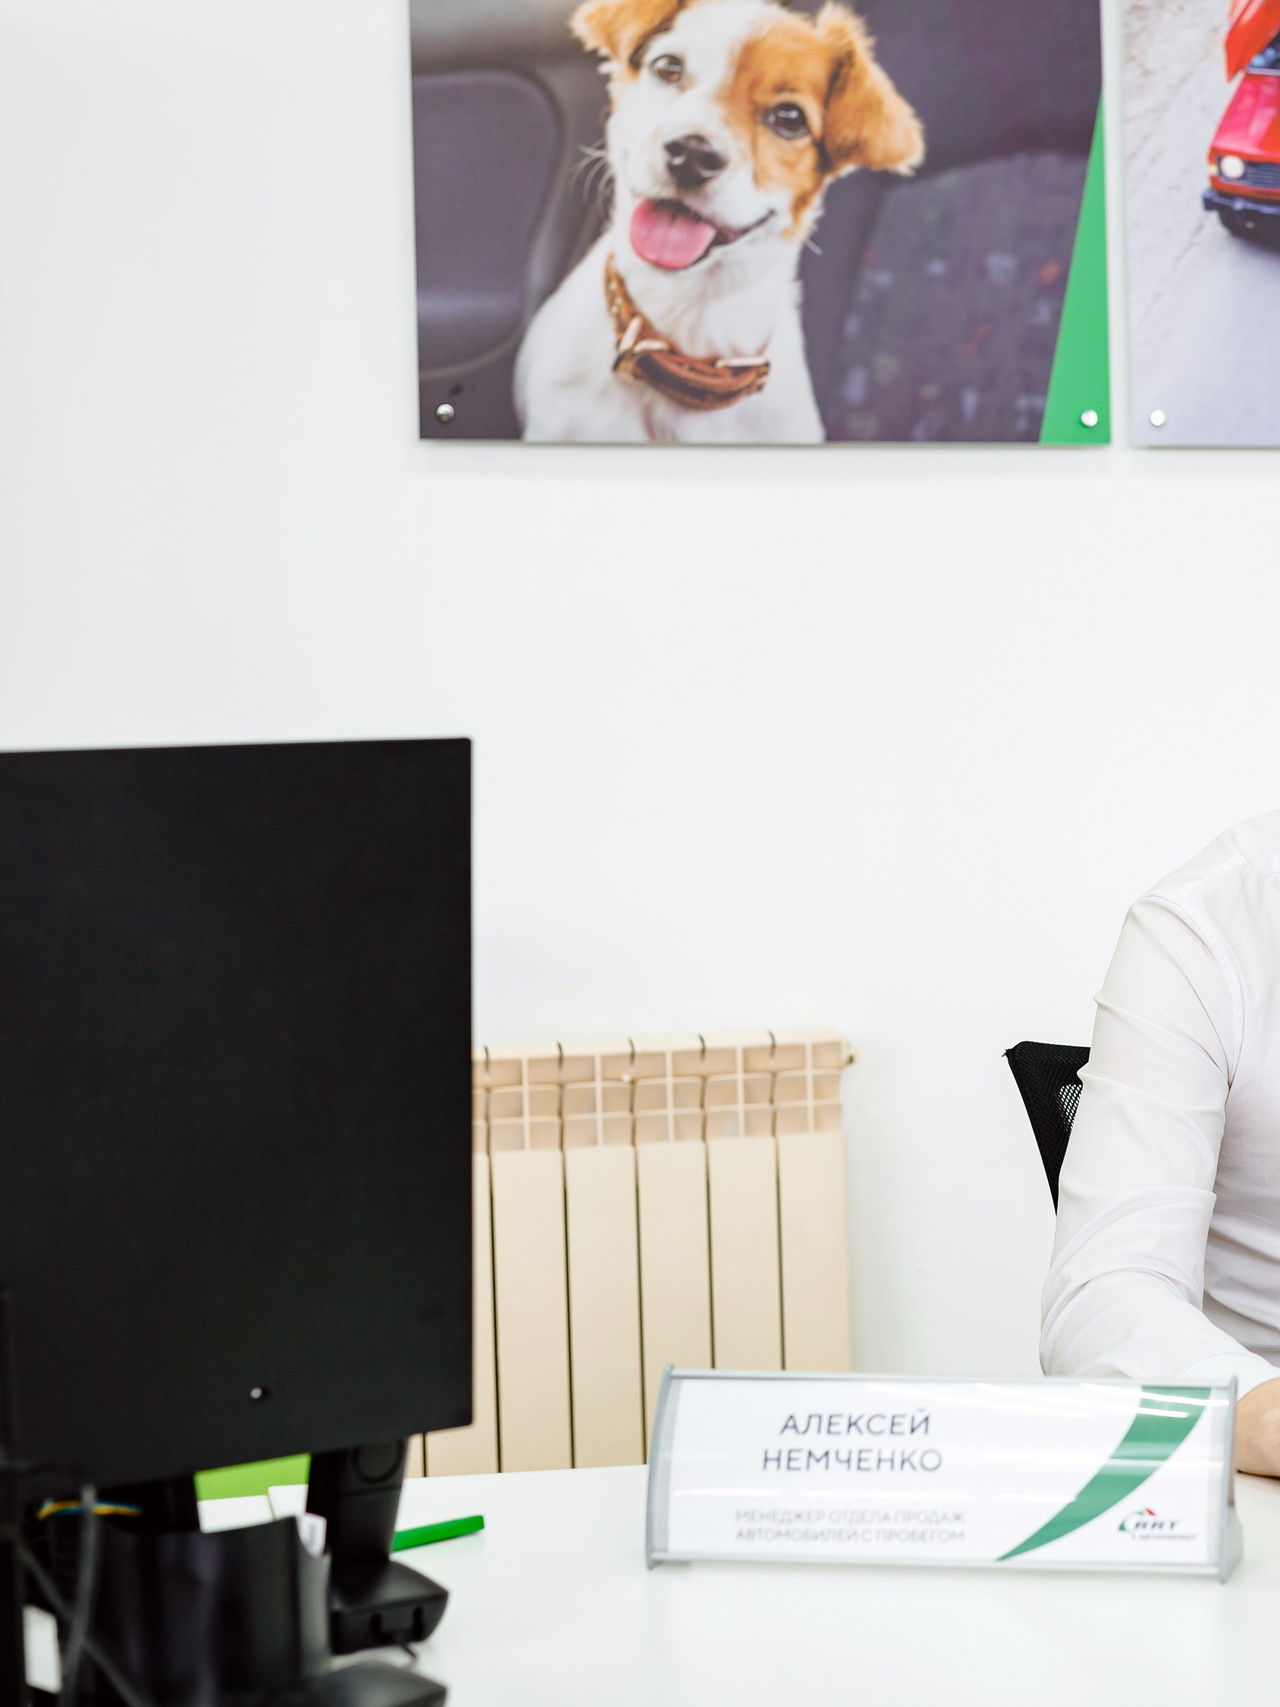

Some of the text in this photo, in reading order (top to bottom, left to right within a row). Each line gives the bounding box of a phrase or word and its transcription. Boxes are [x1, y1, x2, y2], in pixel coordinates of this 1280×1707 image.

[779, 1406, 931, 1436] АЛЕКСЕЙ
[762, 1448, 943, 1472] НЕМЧЕНКО
[735, 1508, 966, 1525] МЕНЕДЖЕР ОТДЕЛА ПРОДАЖ
[735, 1526, 859, 1544] АВТОМОБИЛЕЙ
[875, 1527, 966, 1544] ПРОБЕГОМ
